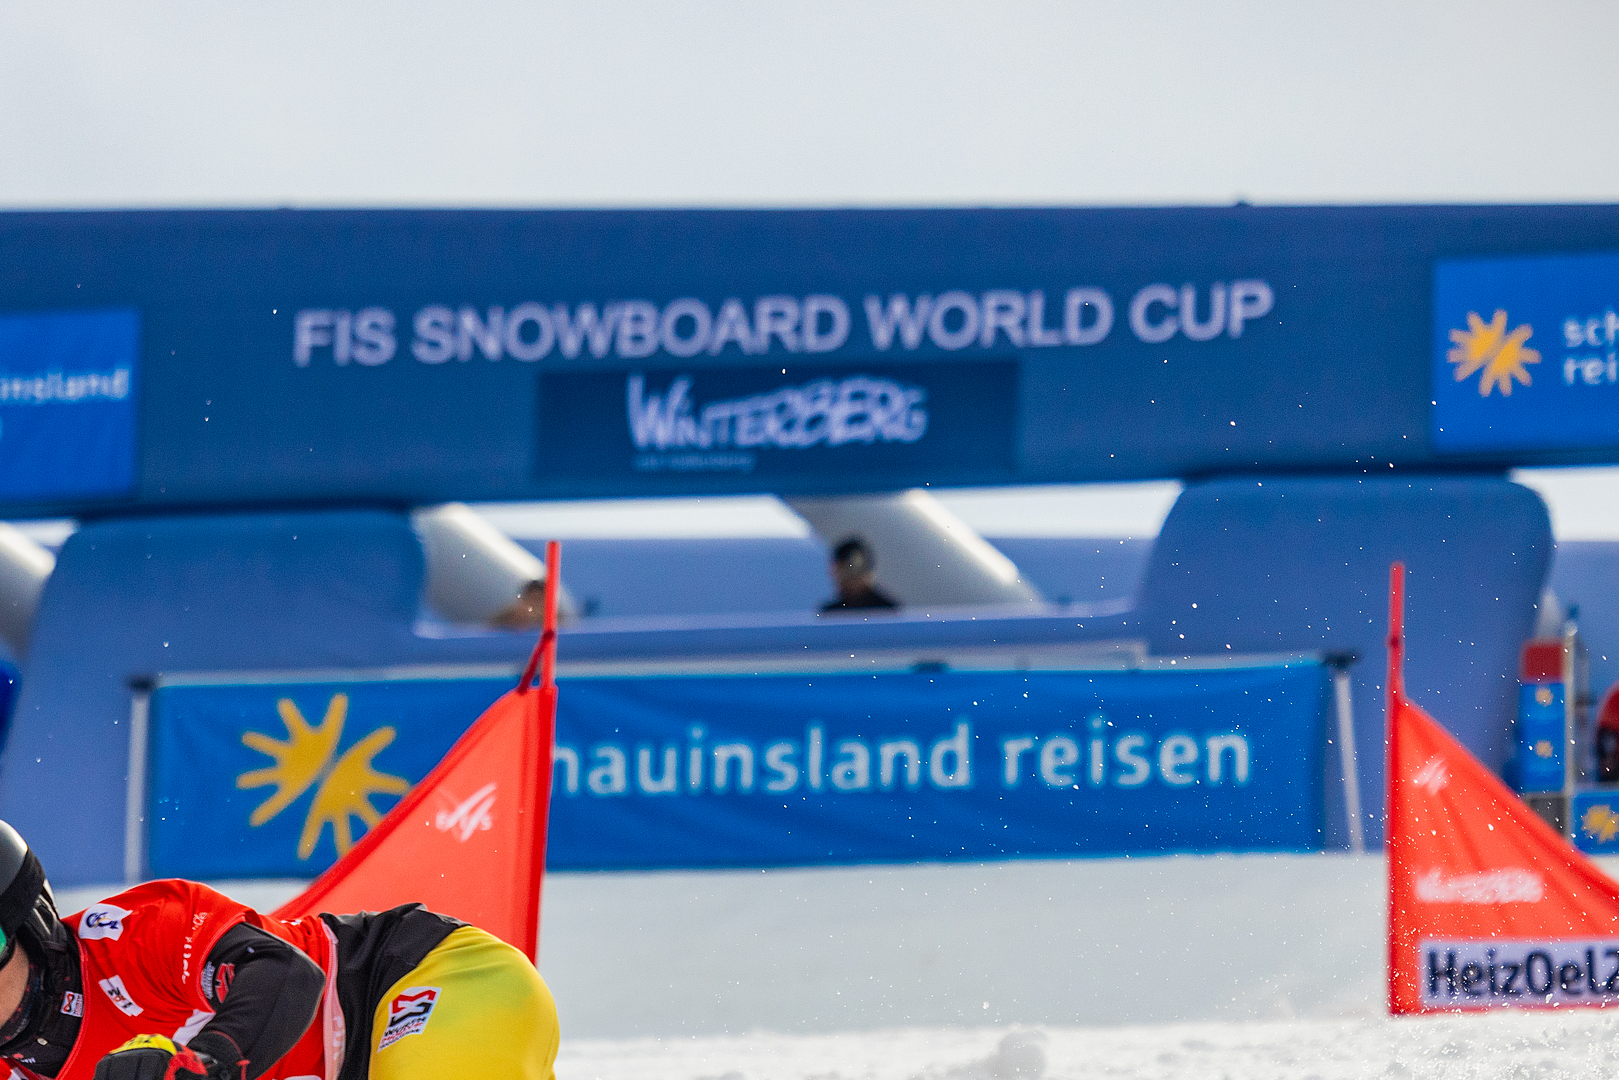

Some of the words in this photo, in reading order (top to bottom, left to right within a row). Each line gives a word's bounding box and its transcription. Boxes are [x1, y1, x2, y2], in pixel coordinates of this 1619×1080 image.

[294, 305, 397, 367] FIS
[411, 294, 851, 364] SNOWBOARD
[863, 287, 1115, 351] WORLD
[1129, 279, 1275, 344] CUP
[1001, 713, 1251, 789] reisen
